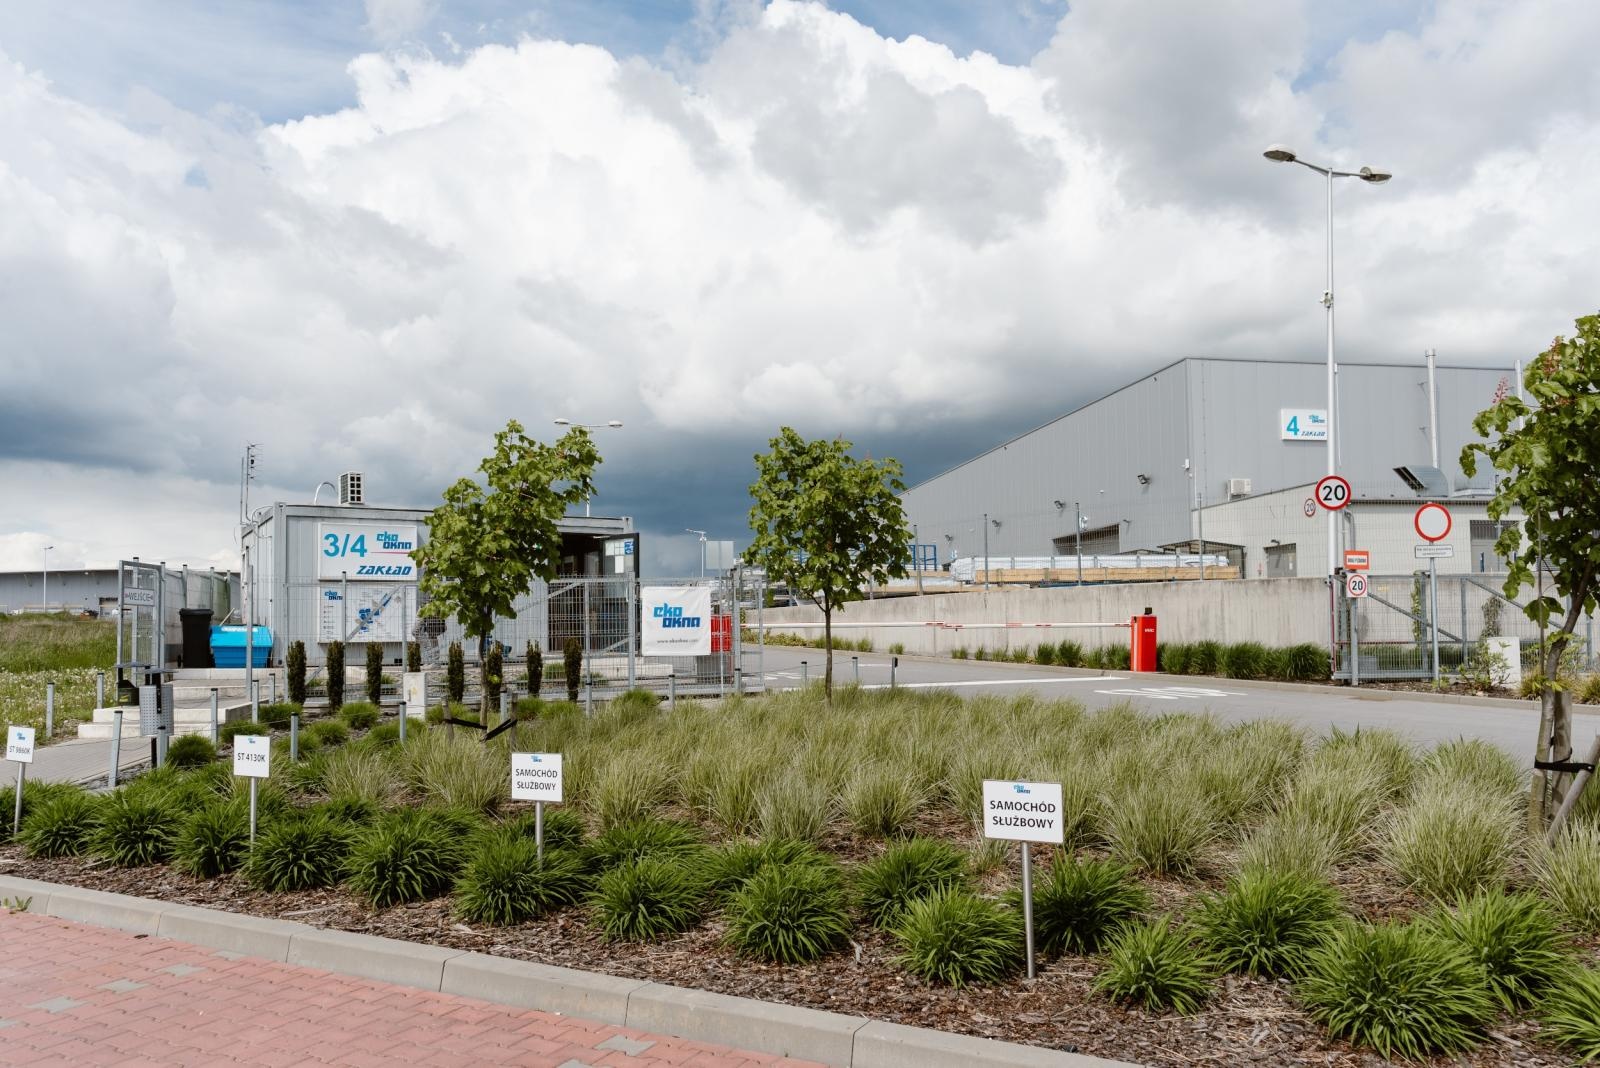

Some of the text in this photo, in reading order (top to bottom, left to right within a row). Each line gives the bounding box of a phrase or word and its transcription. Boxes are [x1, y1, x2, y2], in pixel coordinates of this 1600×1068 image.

[1286, 415, 1300, 436] 4
[1322, 485, 1346, 501] 20
[323, 533, 368, 558] 3/4
[1351, 580, 1364, 591] 20
[237, 752, 245, 761] ST
[515, 768, 558, 778] SAMOCHÓD
[989, 800, 1056, 813] SAMOCHÓD
[992, 815, 1054, 829] SŁUŻBOWY
